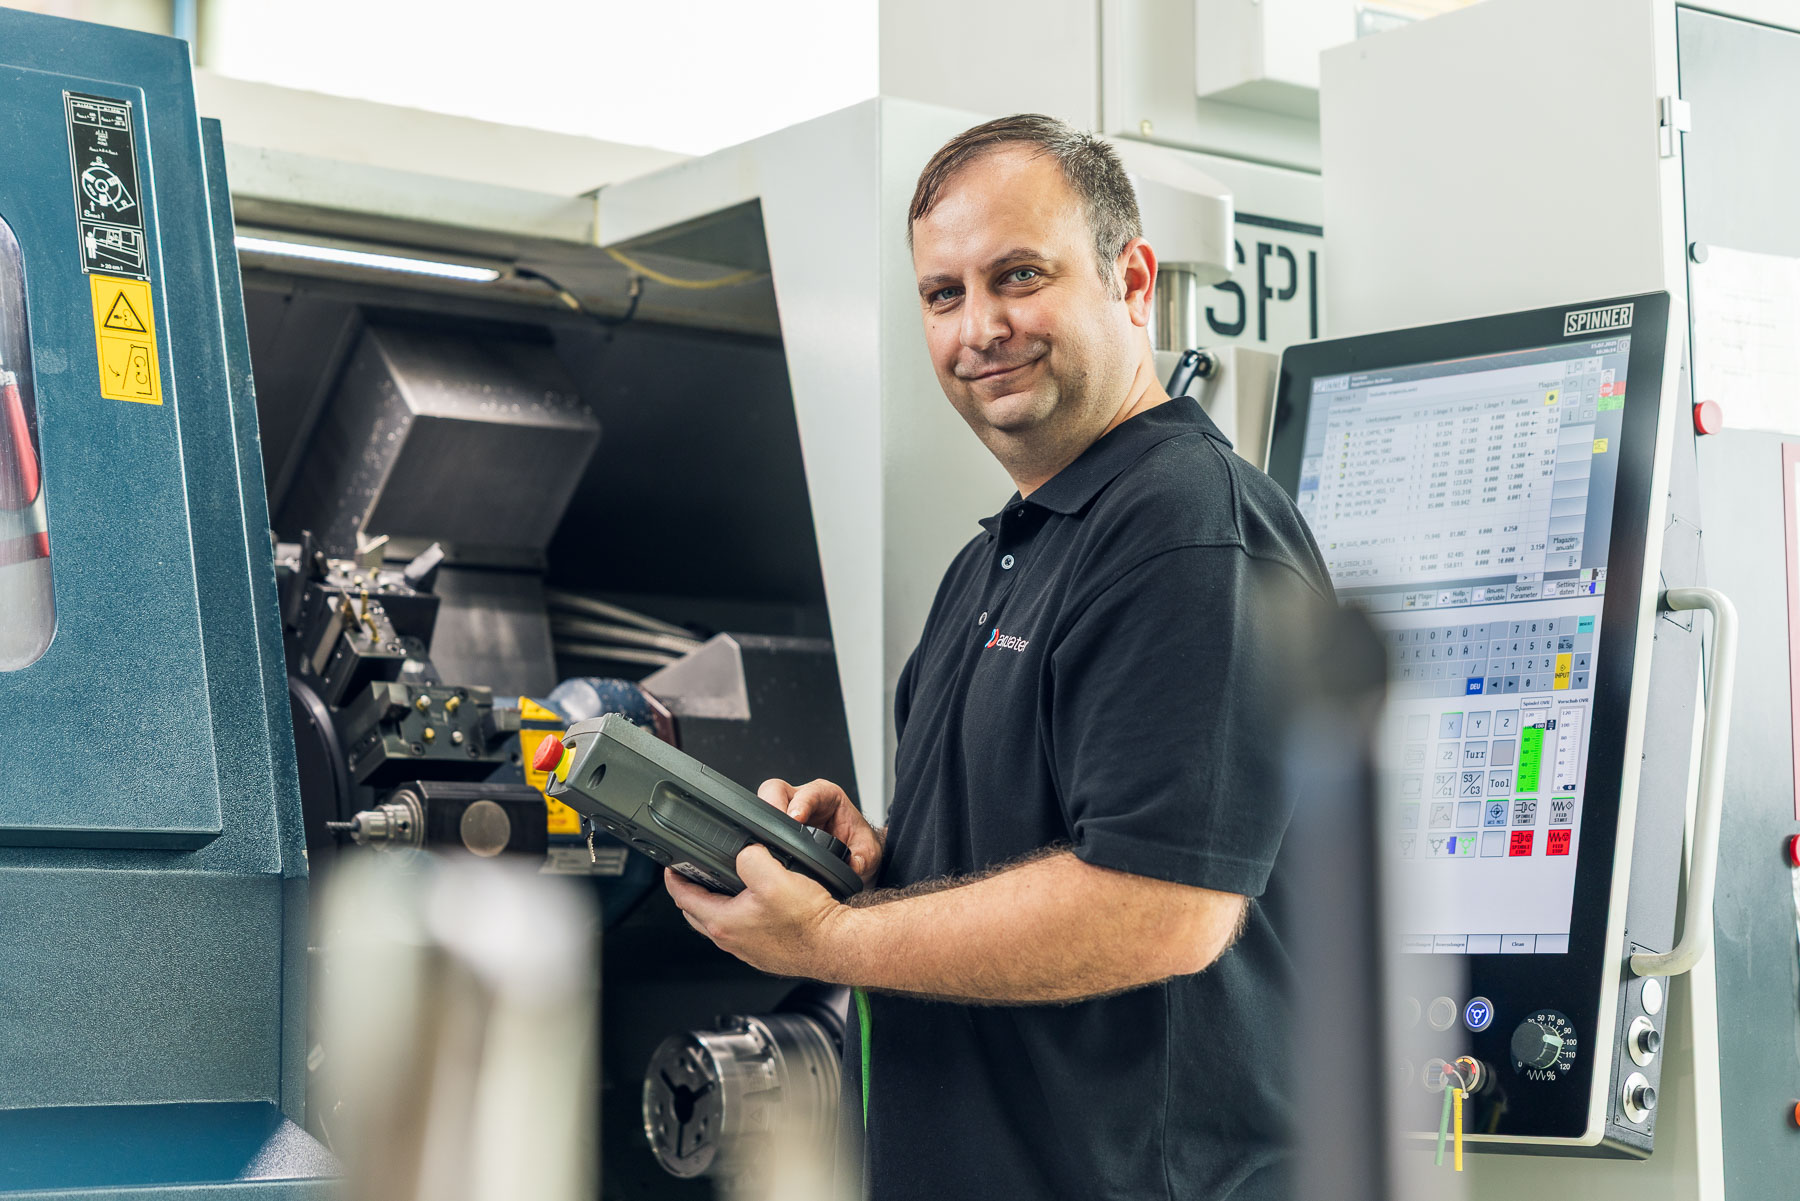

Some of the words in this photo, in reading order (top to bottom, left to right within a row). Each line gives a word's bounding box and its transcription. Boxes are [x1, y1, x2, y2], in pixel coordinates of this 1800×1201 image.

[1568, 307, 1629, 332] SPINNER
[1510, 592, 1538, 600] Parameter
[1462, 627, 1468, 638] Ü
[1514, 624, 1520, 634] 7
[1531, 623, 1537, 632] 8
[1548, 622, 1554, 631] 9
[1447, 646, 1453, 656] Ö
[1512, 642, 1518, 652] 4
[1530, 641, 1535, 650] 5
[1546, 640, 1552, 650] 6
[1527, 660, 1533, 670] 2
[1544, 658, 1550, 668] 3
[1448, 721, 1454, 730] X
[1476, 720, 1482, 729] Y
[1503, 718, 1510, 728] Z
[1465, 750, 1486, 759] Turr
[1463, 774, 1473, 783] S3
[1490, 778, 1510, 788] Tool
[1442, 786, 1452, 796] C1
[1470, 786, 1480, 795] C3
[1547, 1014, 1556, 1022] 70
